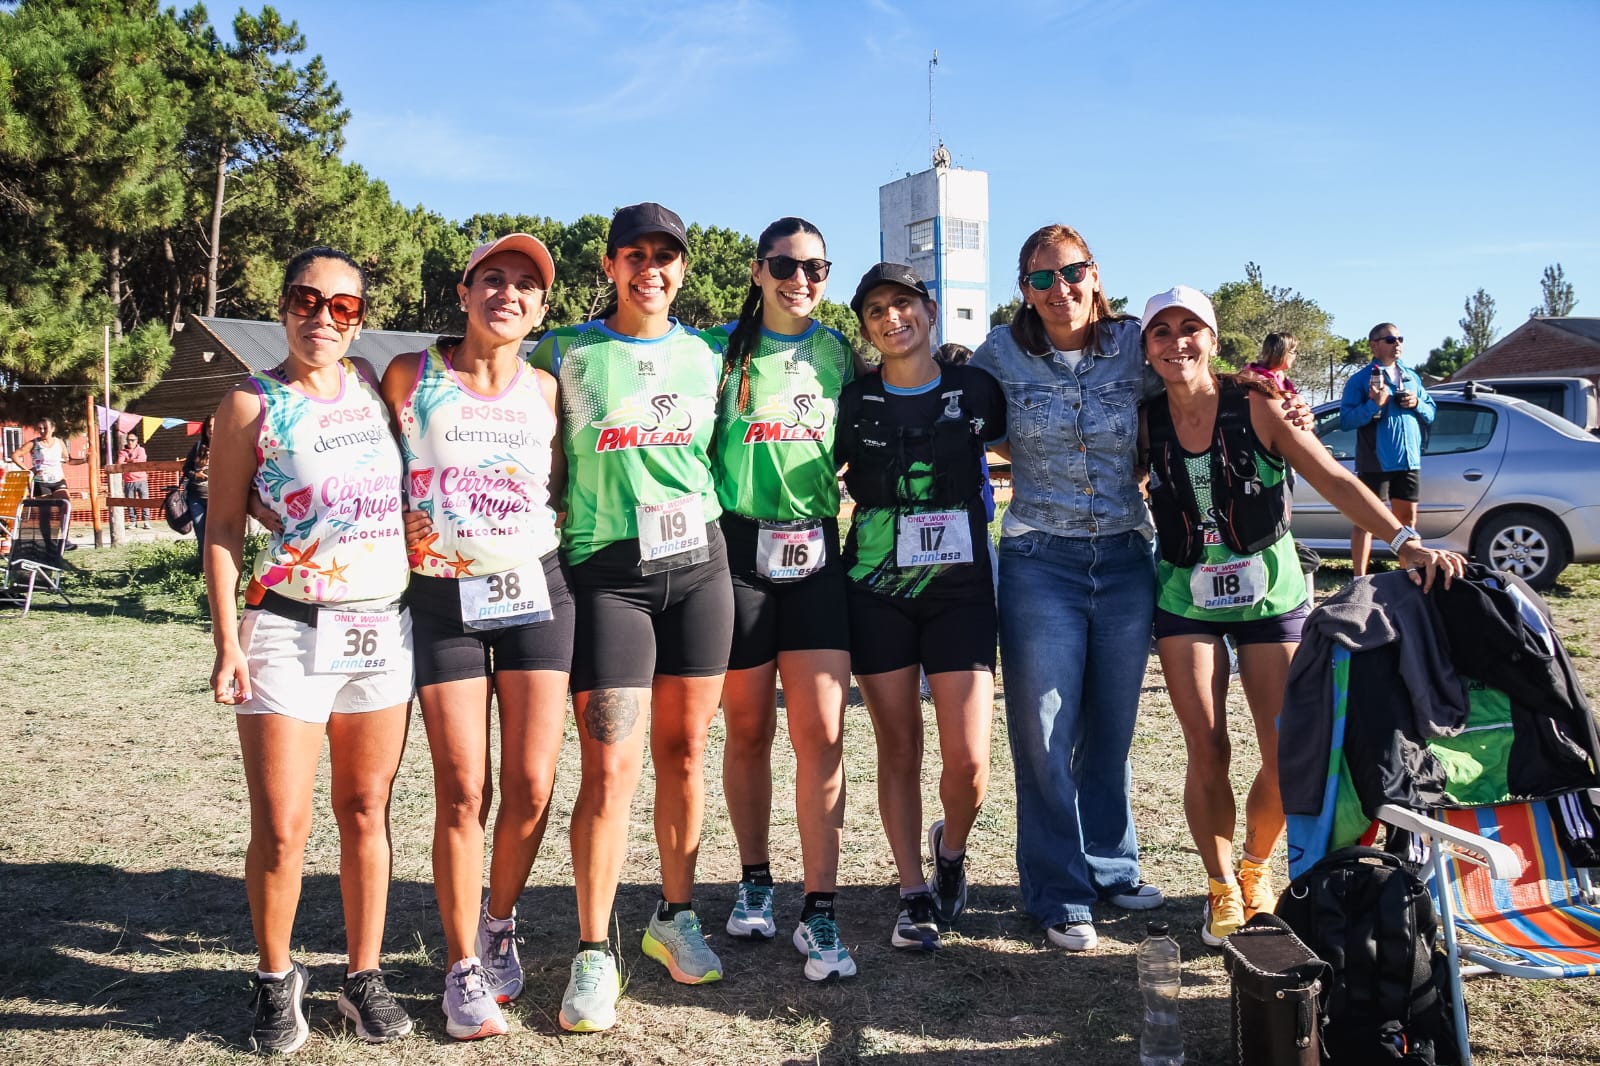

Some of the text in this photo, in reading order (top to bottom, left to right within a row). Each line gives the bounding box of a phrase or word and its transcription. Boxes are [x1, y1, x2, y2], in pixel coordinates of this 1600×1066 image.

[463, 467, 478, 478] La
[441, 498, 454, 509] de
[468, 493, 531, 520] Mujer
[644, 505, 664, 513] ONLY
[929, 514, 957, 522] WOMAN
[457, 527, 520, 539] NECOCHEA
[660, 511, 687, 542] 119
[772, 532, 790, 540] ONLY
[920, 526, 946, 552] 117
[651, 537, 699, 558] printesa
[781, 544, 809, 567] 116
[911, 551, 961, 565] printesa
[1222, 560, 1251, 571] WOMAN
[486, 572, 521, 603] 38
[1212, 574, 1240, 597] 118
[1204, 595, 1254, 608] printesa
[479, 600, 534, 619] printesa
[334, 615, 357, 623] ONLY
[344, 629, 378, 656] 36
[330, 658, 386, 671] printesa
